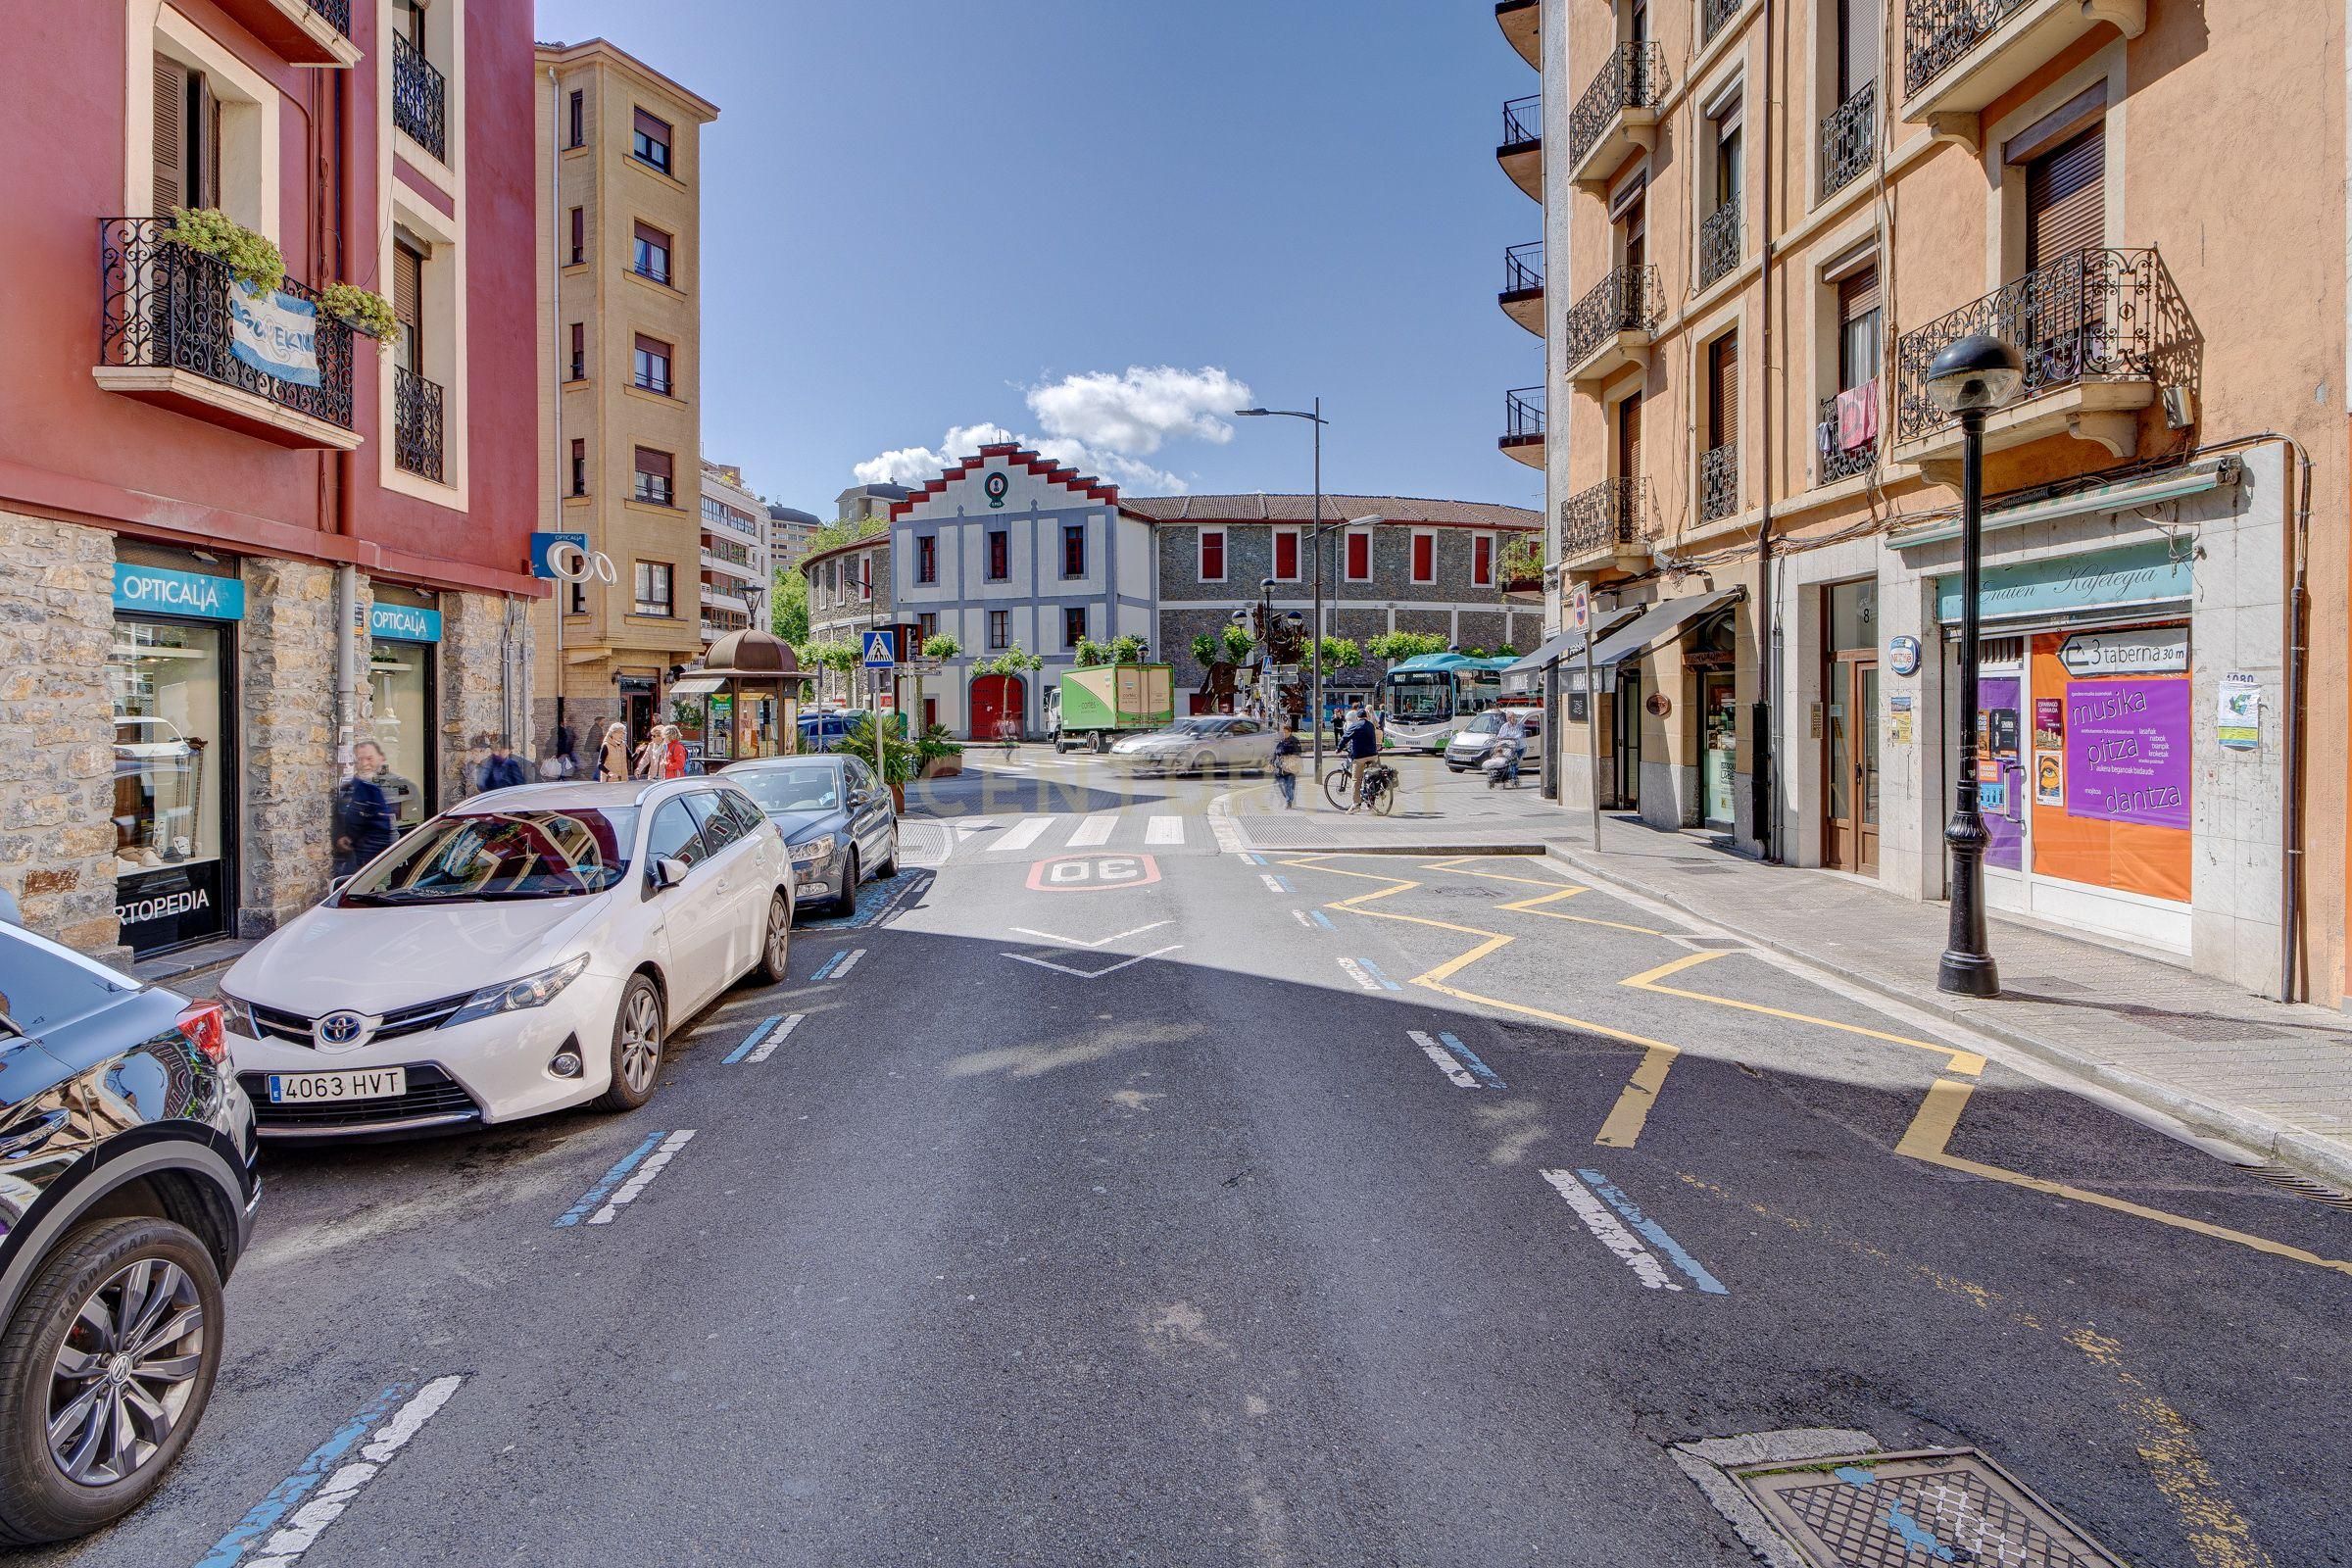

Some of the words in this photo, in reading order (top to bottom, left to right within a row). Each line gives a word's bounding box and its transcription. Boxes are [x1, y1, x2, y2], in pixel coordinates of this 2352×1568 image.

[2053, 564, 2158, 599] Kafetegia
[1863, 608, 1870, 623] 8
[2091, 639, 2101, 665] 3
[2103, 643, 2160, 664] taberna
[2162, 647, 2173, 661] 30
[2176, 650, 2184, 660] m
[2073, 688, 2147, 726] musika
[2087, 738, 2139, 771] pitza
[2105, 785, 2181, 814] dantza
[1051, 858, 1138, 882] 30
[113, 888, 210, 926] RTOPEDIA
[285, 1077, 344, 1099] 4063
[353, 1072, 398, 1096] HVT
